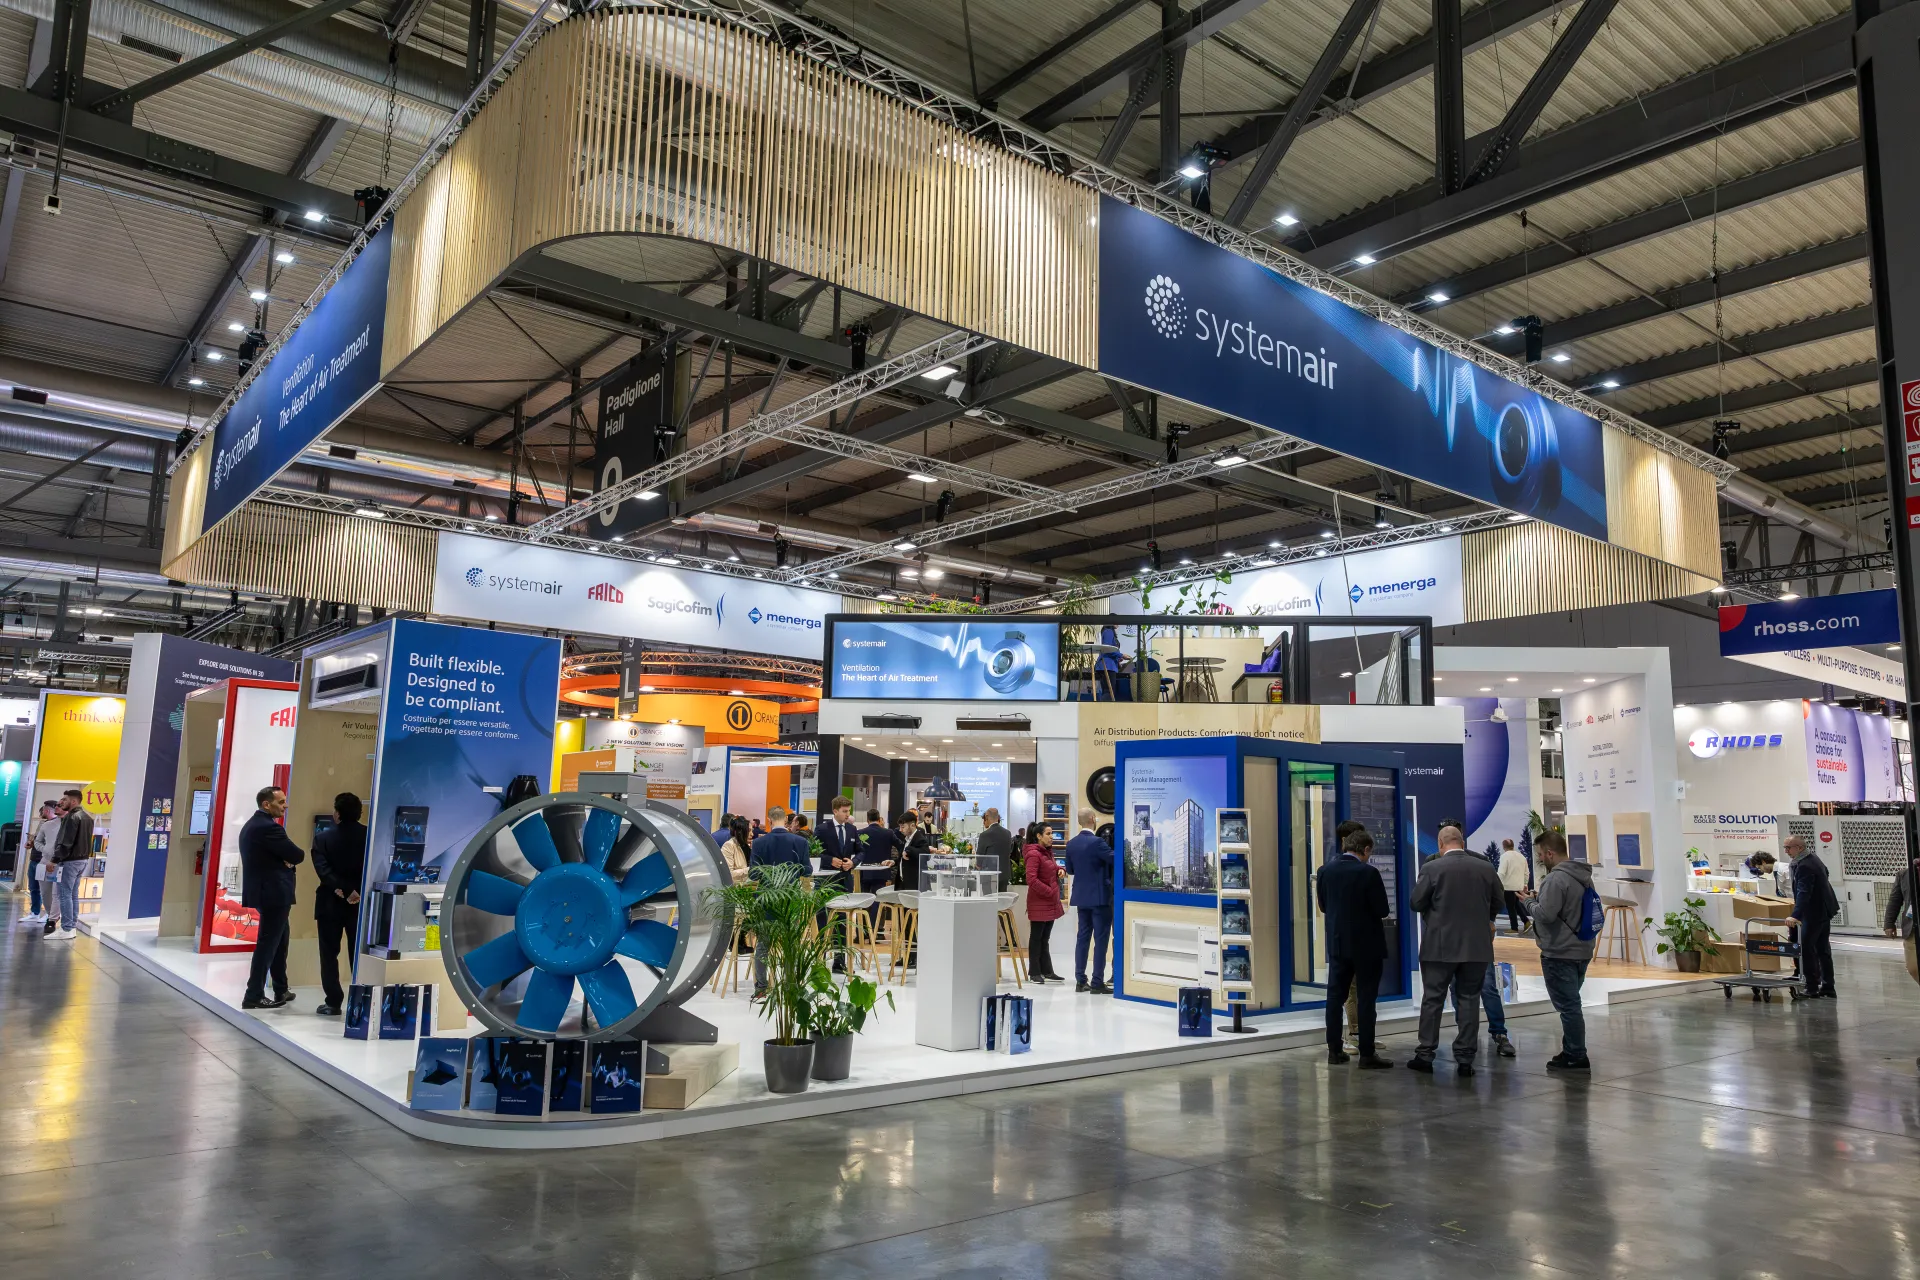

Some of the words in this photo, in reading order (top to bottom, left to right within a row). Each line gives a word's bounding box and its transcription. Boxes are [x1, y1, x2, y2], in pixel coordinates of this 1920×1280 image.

[1195, 308, 1338, 390] systemair
[279, 407, 290, 431] The
[291, 385, 309, 420] Heart
[309, 373, 319, 402] of
[317, 365, 329, 394] Air
[329, 324, 370, 382] Treatment
[282, 353, 315, 399] Ventilation
[606, 372, 661, 415] Padiglione
[604, 413, 625, 439] Hall
[223, 415, 262, 481] systemair
[489, 574, 563, 596] systemair
[588, 582, 624, 604] FRICO
[1368, 577, 1437, 595] menerga
[647, 596, 713, 616] SagiCofim
[766, 612, 822, 630] menerga
[1754, 615, 1861, 637] rhoss.com
[852, 640, 887, 648] systemair
[199, 659, 219, 669] EXPLORE
[229, 664, 252, 676] SOLUTIONS
[409, 652, 444, 670] Built
[447, 656, 506, 676] flexible.
[841, 664, 880, 672] Ventilation
[1816, 653, 1858, 675] MULTI-PURPOSE
[1859, 665, 1881, 681] SYSTEMS
[1886, 674, 1894, 684] AIR
[407, 672, 477, 692] Designed
[481, 680, 496, 694] to
[623, 667, 635, 699] L
[841, 673, 855, 682] The
[857, 673, 877, 682] Heart
[878, 674, 887, 682] of
[887, 674, 899, 682] Air
[900, 674, 938, 682] Treatment
[405, 691, 425, 707] be
[429, 696, 505, 714] compliant.
[341, 721, 354, 729] Air
[403, 714, 438, 724] Costruito
[438, 718, 452, 726] per
[453, 719, 478, 727] essere
[479, 721, 512, 730] versatile.
[402, 724, 443, 734] Progettato
[444, 728, 458, 736] per
[458, 729, 483, 737] essere
[484, 731, 520, 740] conforme.
[1094, 728, 1106, 736] Air
[1108, 728, 1156, 736] Distribution
[1158, 728, 1198, 737] Products:
[1253, 730, 1276, 738] don't
[1278, 730, 1305, 739] notice
[1815, 728, 1819, 739] A
[1820, 731, 1847, 744] conscious
[624, 739, 652, 747] SOLUTIONS
[1706, 735, 1783, 748] RHOSS
[1816, 742, 1834, 756] choice
[1816, 758, 1848, 772] sustainable
[1148, 776, 1182, 784] Management
[1817, 770, 1837, 784] future.
[1719, 815, 1778, 824] SOLUTION
